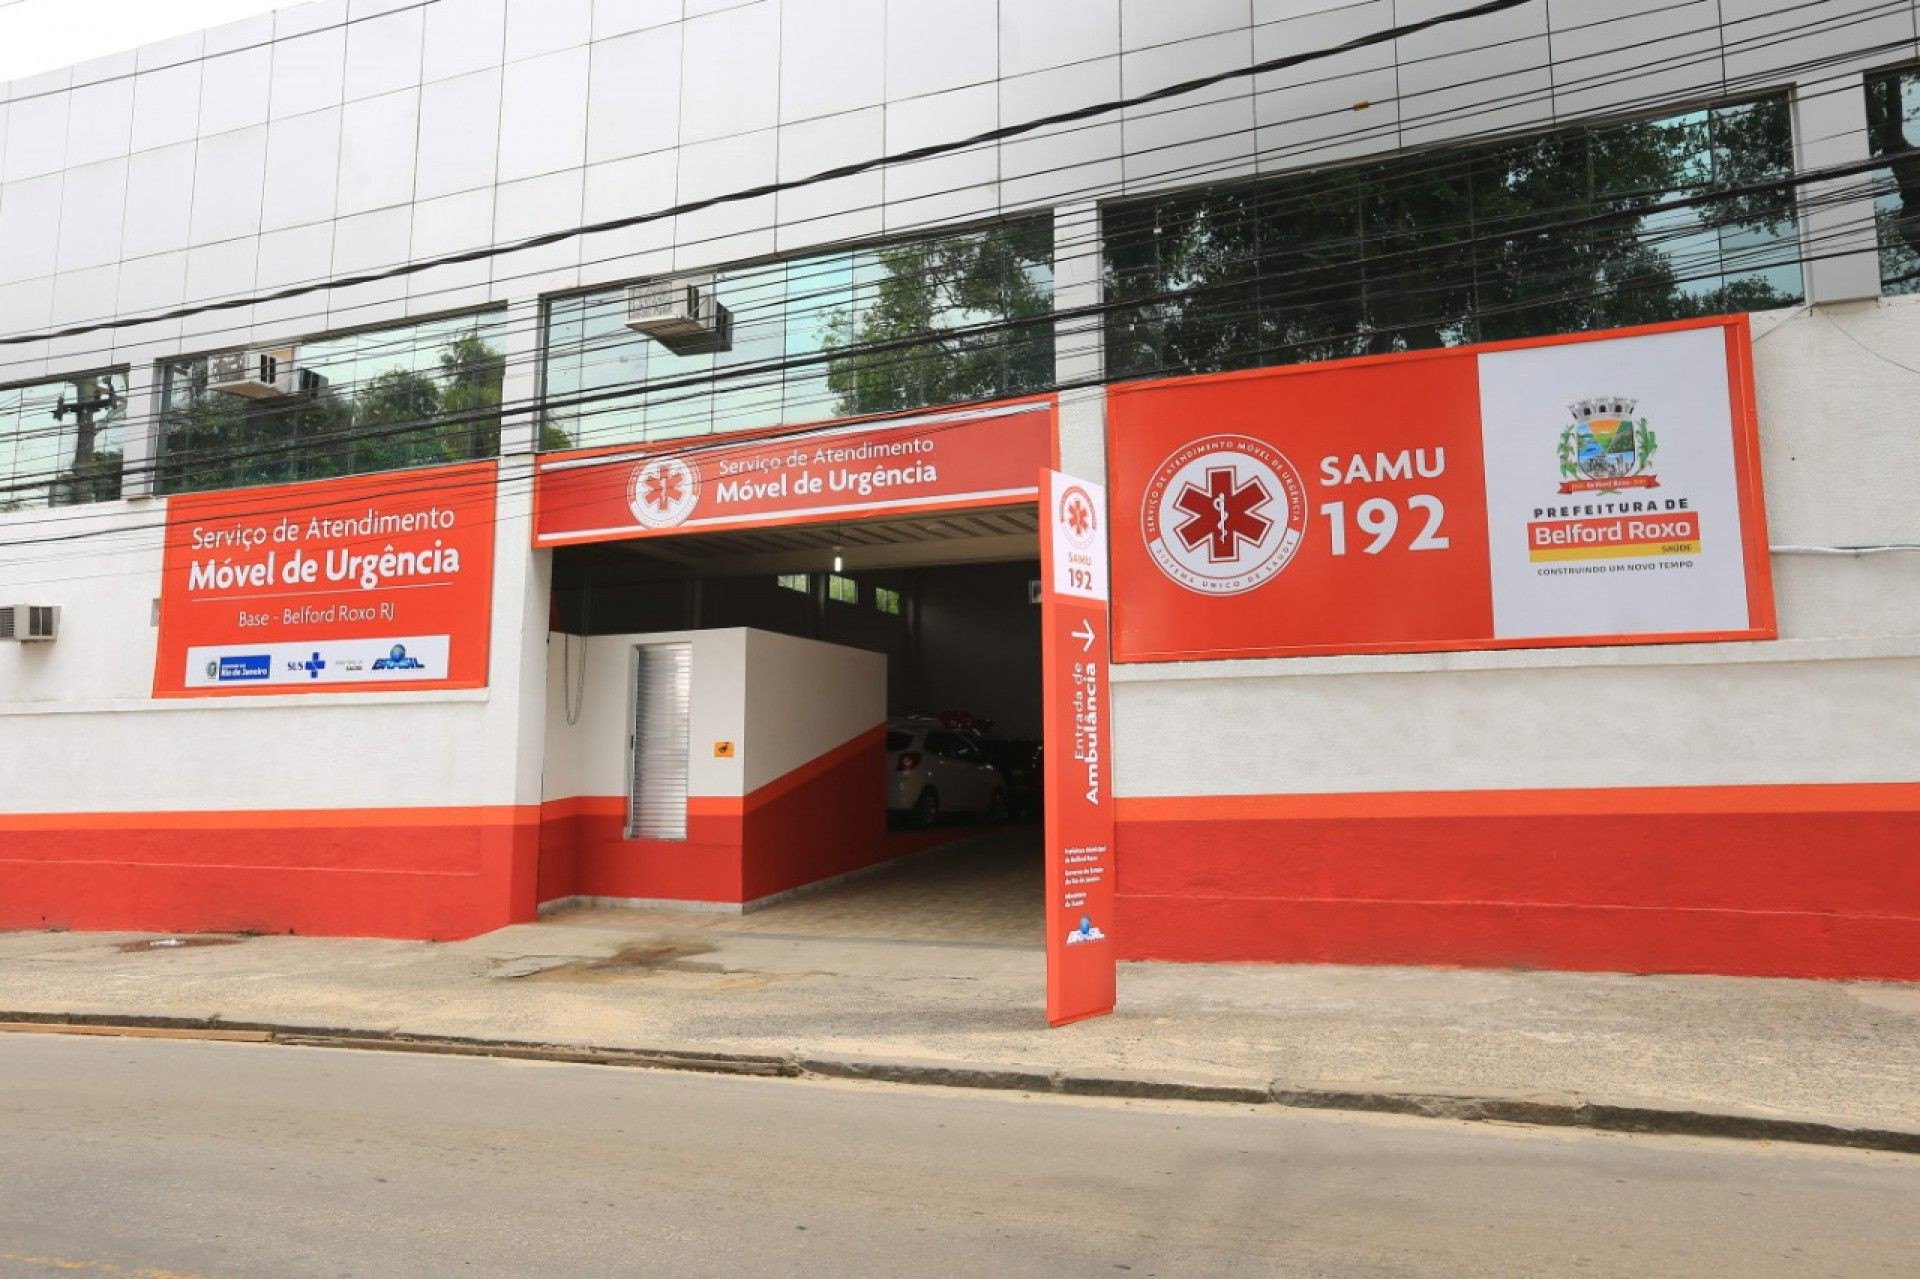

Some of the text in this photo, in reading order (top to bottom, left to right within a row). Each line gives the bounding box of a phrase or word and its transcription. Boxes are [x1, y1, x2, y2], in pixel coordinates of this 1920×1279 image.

[719, 438, 934, 477] Serviço de Atendimento
[1319, 446, 1446, 487] SAMU
[716, 470, 788, 504] Móvel
[796, 467, 821, 494] de
[828, 461, 937, 496] Urgência
[1320, 494, 1450, 556] 192
[1533, 498, 1688, 519] PREFEITURA DE
[191, 507, 455, 551] Serviço de Atendimento
[1535, 520, 1691, 546] Belford Roxo
[187, 539, 460, 592] Móvel de Urgência
[1067, 551, 1092, 566] SAMU
[1537, 560, 1693, 576] CONSTRUINDO UM NOVO TEMPO
[1068, 567, 1092, 591] 192
[238, 611, 269, 627] Base
[283, 605, 335, 625] Belford
[339, 605, 376, 621] Roxo
[380, 603, 395, 622] RJ
[1071, 663, 1084, 760] Entrada de
[1083, 663, 1098, 805] Ambulância
